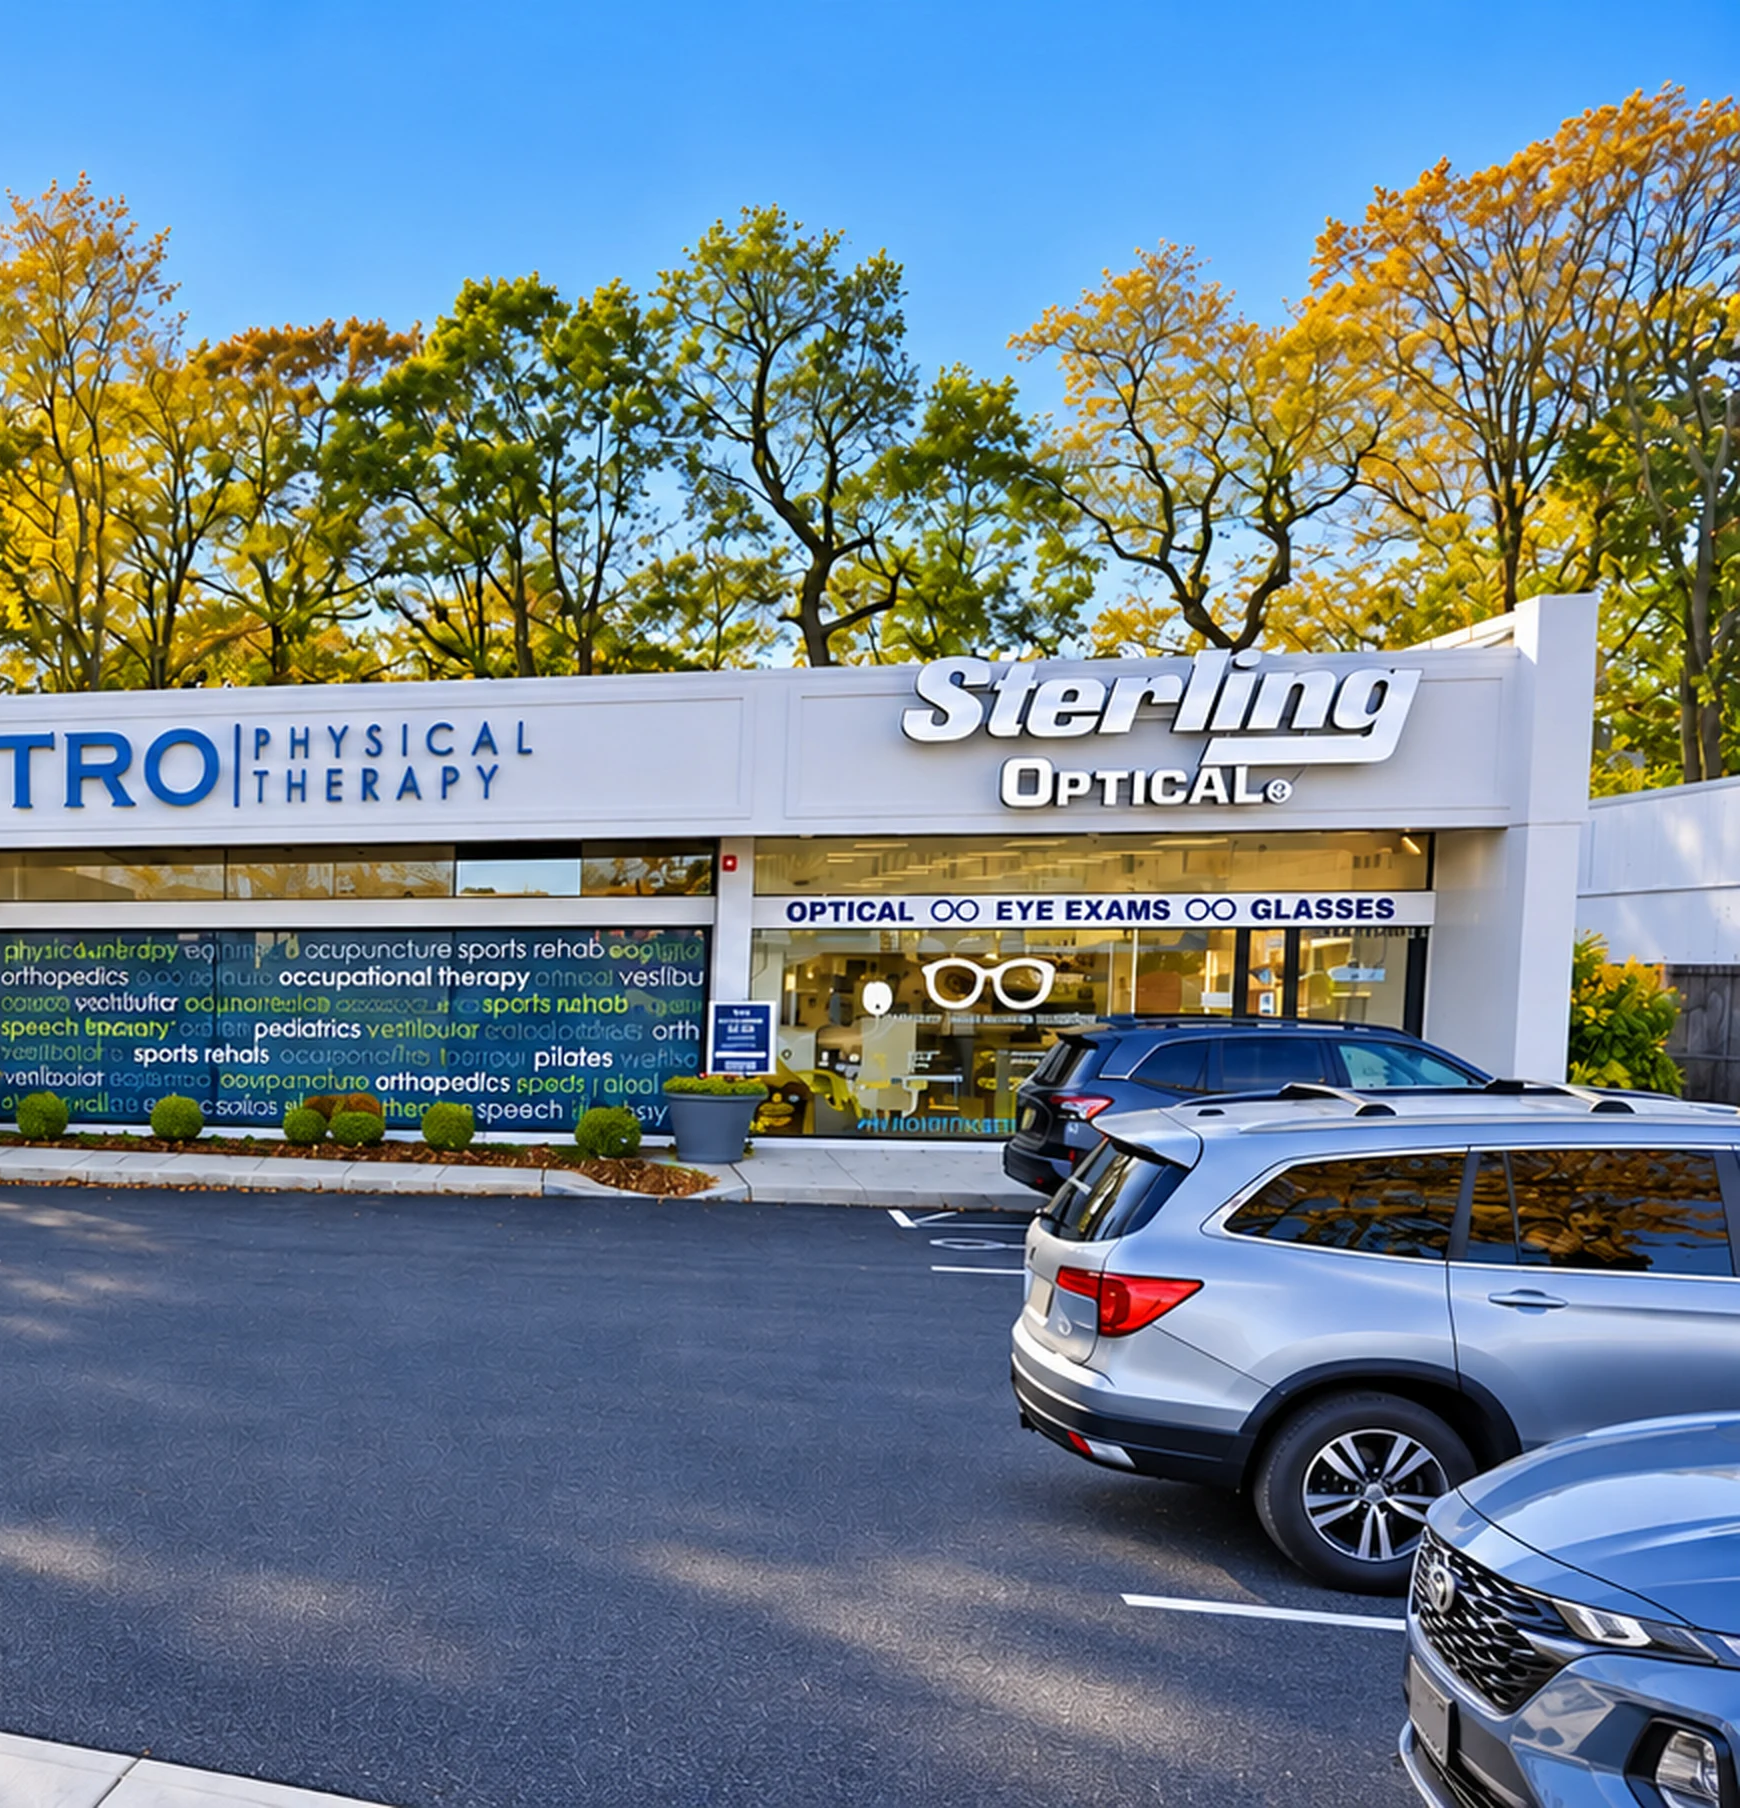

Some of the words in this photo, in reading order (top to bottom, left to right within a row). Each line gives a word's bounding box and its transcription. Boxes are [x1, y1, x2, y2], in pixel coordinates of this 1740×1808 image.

[901, 648, 1423, 766] Sterling
[254, 721, 533, 760] PHYSICAL
[253, 763, 500, 804] THERAPY
[786, 901, 914, 924] OPTICAL
[996, 901, 1053, 922] EYE
[1065, 900, 1171, 922] EXAMS
[1250, 898, 1396, 921] GLASSES
[458, 939, 527, 964] sports
[534, 938, 605, 960] rehab
[1, 966, 129, 990] orthopedics
[279, 965, 432, 991] occupational
[437, 965, 530, 992] therapy
[482, 992, 551, 1019] sports
[1, 1016, 78, 1042] speech
[255, 1017, 361, 1043] pediatrics
[652, 1020, 700, 1040] orth
[133, 1044, 199, 1068] sports
[535, 1046, 613, 1072] pilates
[477, 1099, 563, 1124] speech
